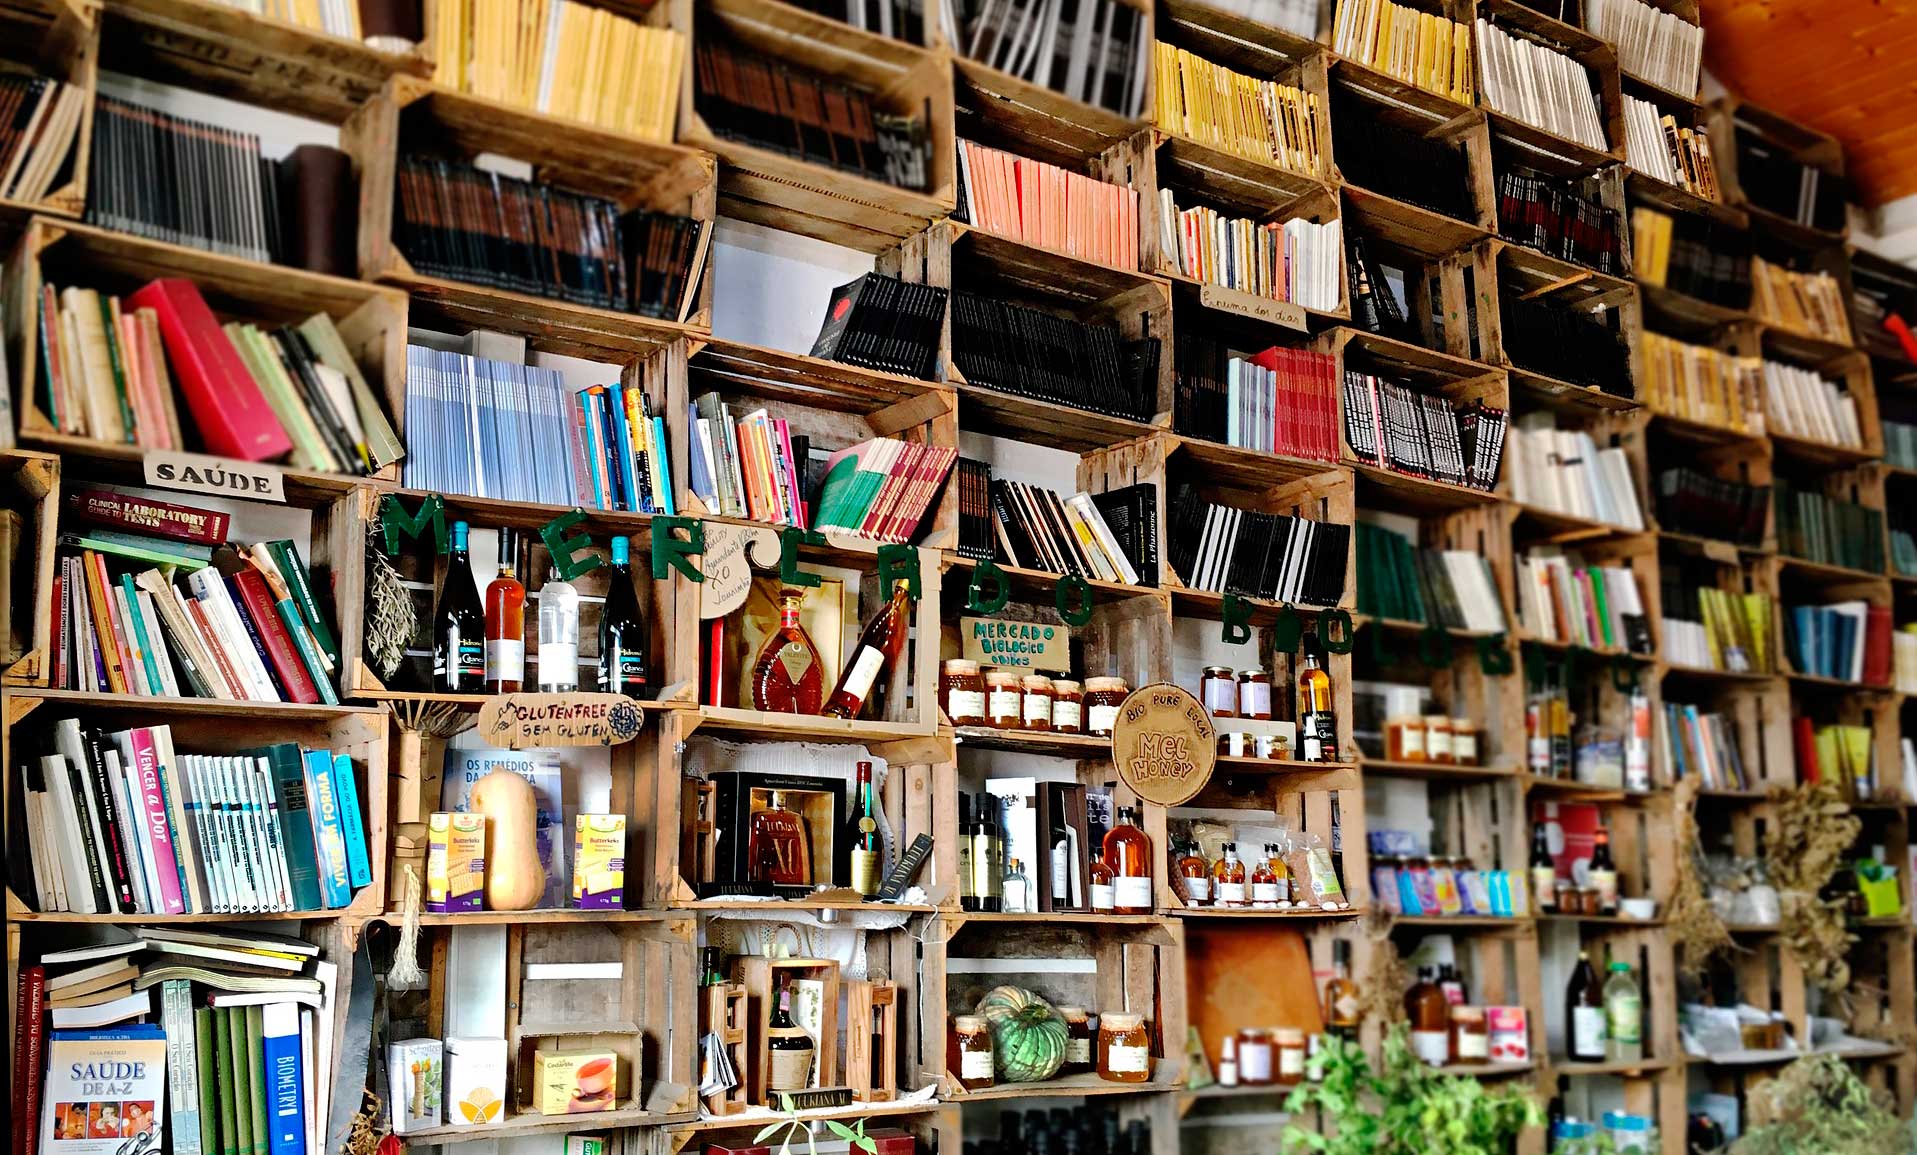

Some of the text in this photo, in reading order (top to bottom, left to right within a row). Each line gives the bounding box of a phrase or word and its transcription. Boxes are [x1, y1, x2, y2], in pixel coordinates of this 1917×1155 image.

[156, 463, 273, 494] SAÚDE
[87, 505, 122, 518] GUIDE TO
[88, 498, 121, 510] CLINICAL
[123, 502, 208, 527] LABORATORY
[123, 512, 160, 528] TESTS
[706, 566, 730, 590] XO
[973, 621, 1055, 640] MERCADO
[1153, 694, 1181, 706] PURE
[1186, 706, 1211, 740] LOCAL
[523, 722, 608, 738] SEM GLUTEN
[466, 759, 480, 771] OS
[466, 772, 479, 783] DA
[140, 747, 167, 844] VENCER a Dor
[320, 771, 335, 821] FORMA
[71, 1060, 146, 1081] SAÚDE
[276, 1055, 296, 1105] BIOMETRY
[82, 1081, 133, 1096] DE A-Z
